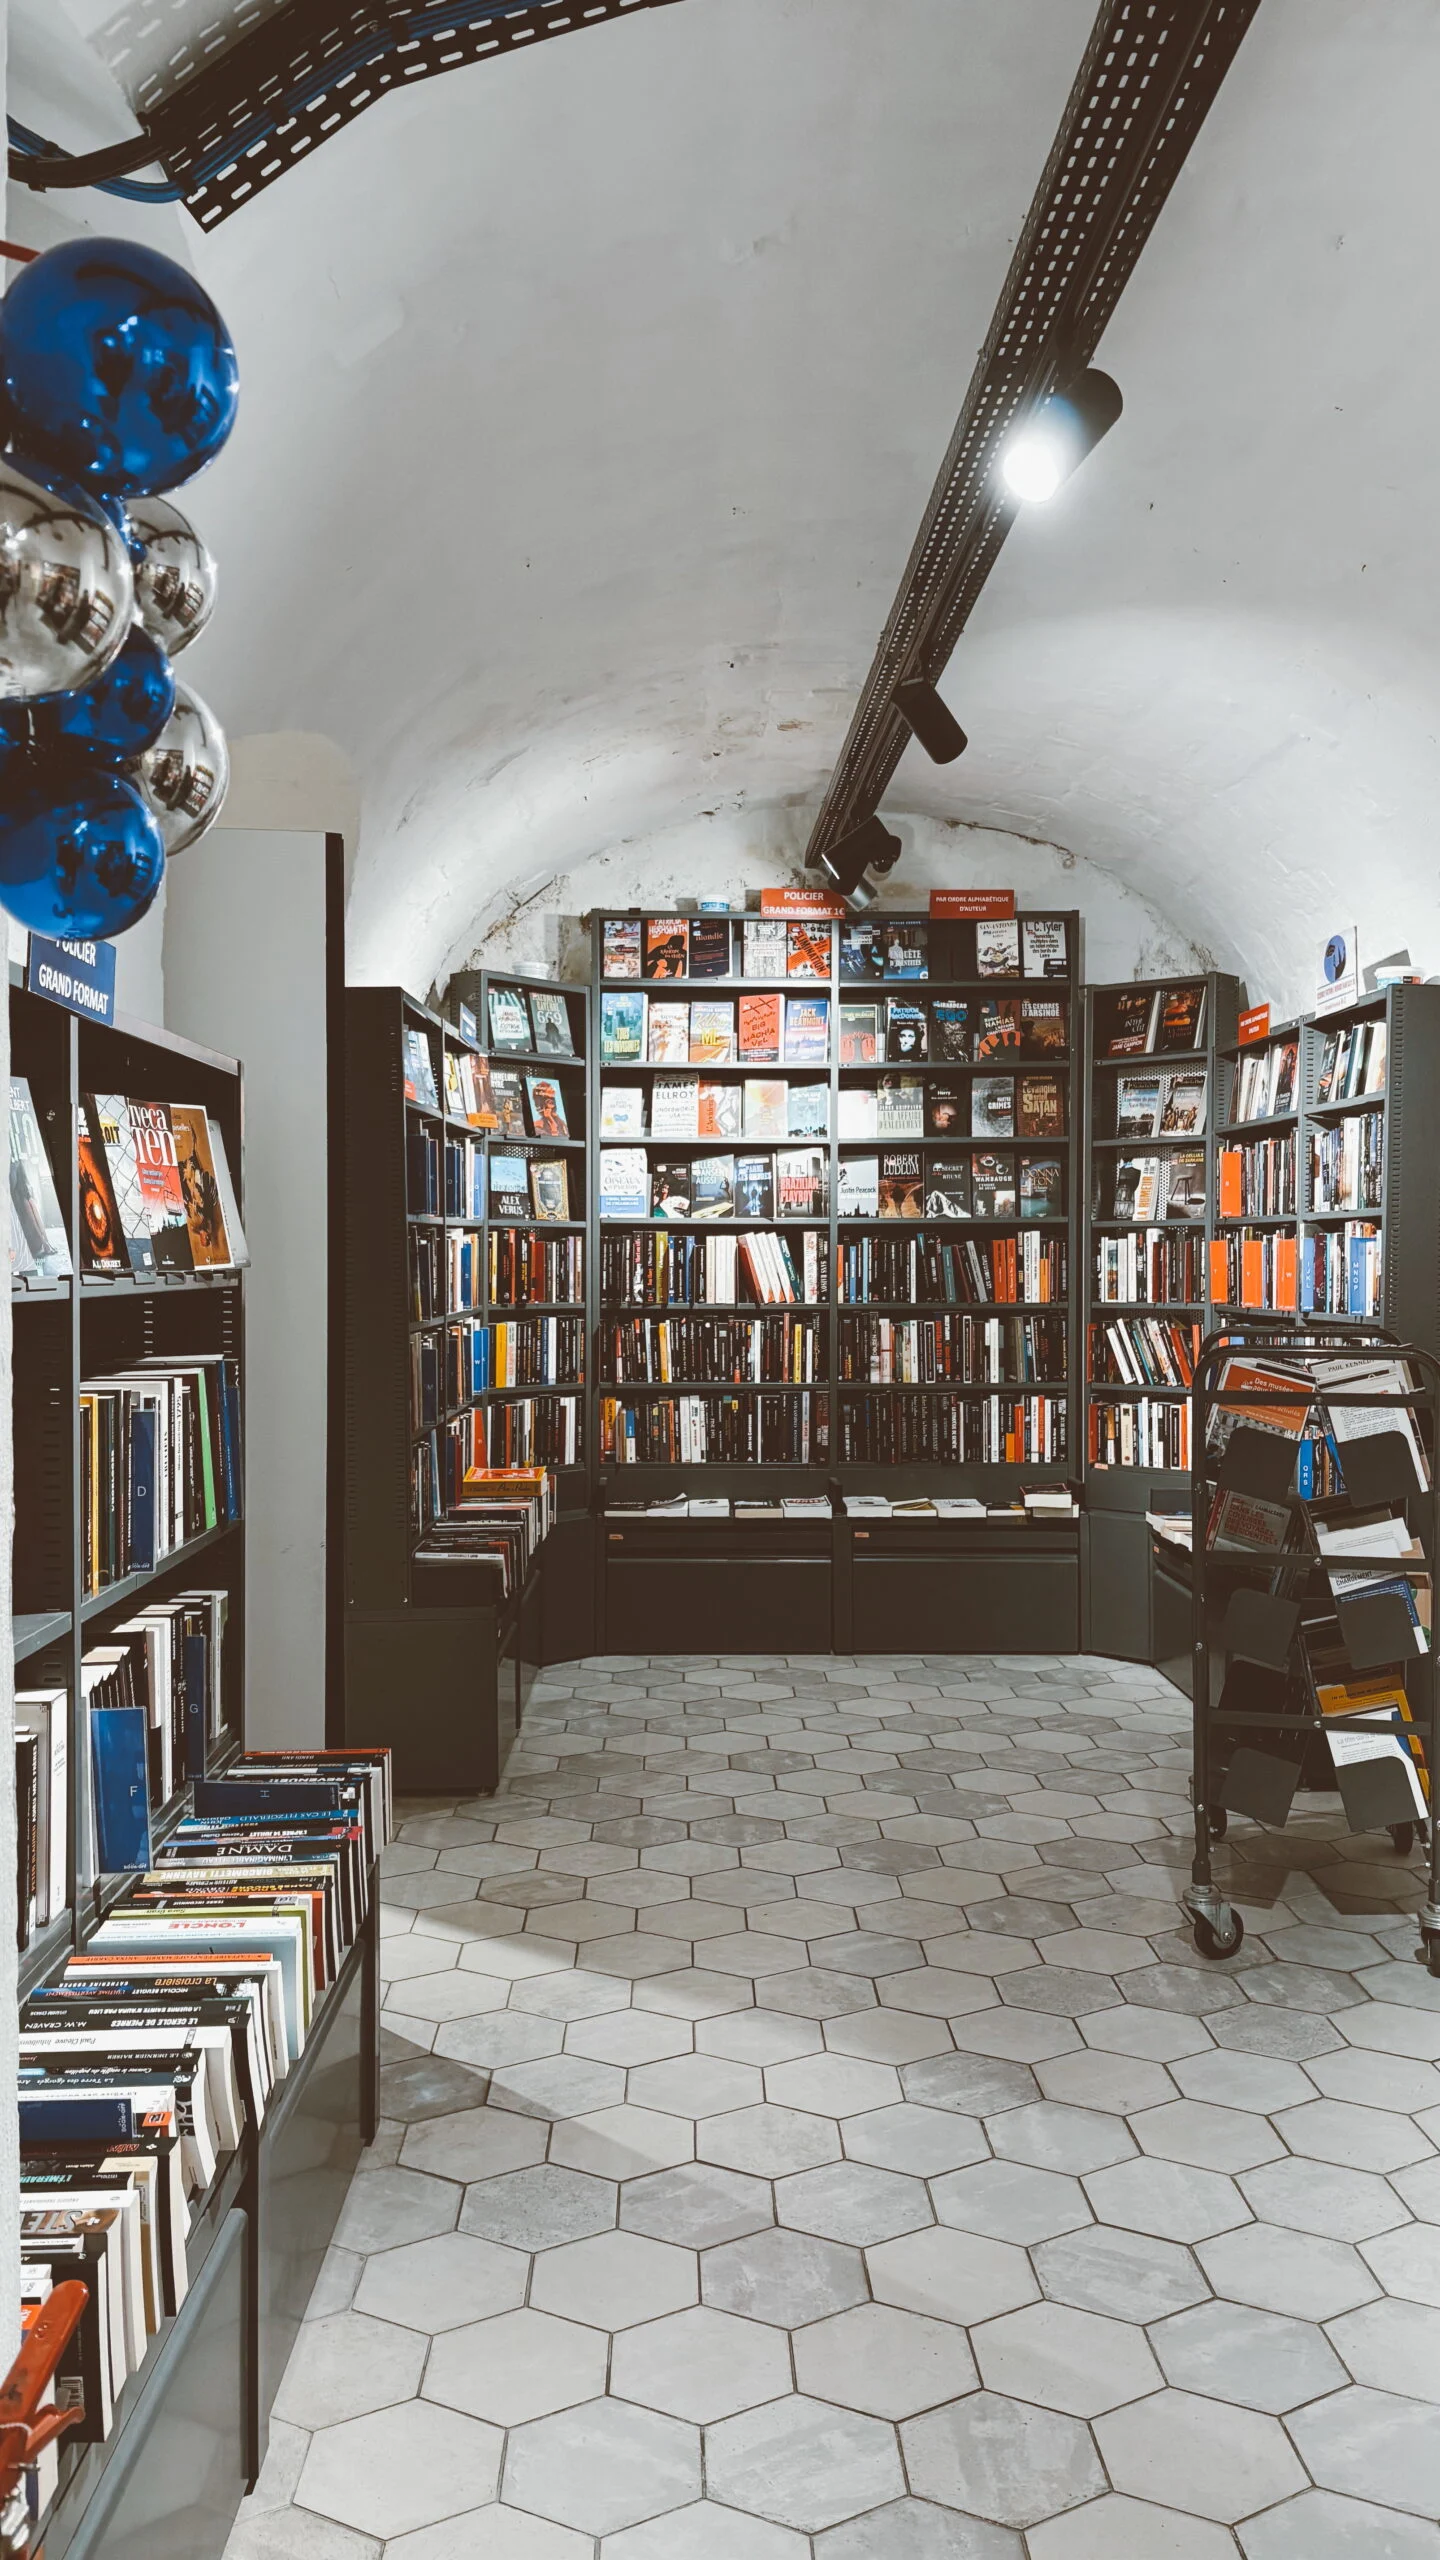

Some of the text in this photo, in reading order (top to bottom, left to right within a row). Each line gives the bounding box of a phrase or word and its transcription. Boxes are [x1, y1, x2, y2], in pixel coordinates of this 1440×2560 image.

[784, 892, 824, 900] POLICIER
[763, 906, 795, 914] GRAND
[796, 907, 832, 915] FORMAT
[1043, 921, 1062, 934] Tyler
[39, 964, 109, 1015] GRAND FORMAT
[537, 1011, 562, 1023] 669
[752, 1021, 765, 1030] BIG
[985, 1017, 1014, 1028] NAMIAS
[656, 1091, 695, 1099] ELLROY
[988, 1102, 1011, 1110] GRIMES
[884, 1154, 919, 1165] ROBERT
[884, 1163, 919, 1176] LUDLUM
[1022, 1169, 1059, 1177] DONNA
[780, 1177, 819, 1189] BRAZILIAN
[501, 1196, 520, 1205] ALEX
[780, 1190, 813, 1203] PLAYBOY
[498, 1205, 523, 1215] VERUS
[1328, 1364, 1342, 1372] PAUL
[1254, 1378, 1294, 1392] Des musées
[138, 1486, 146, 1497] D
[189, 1704, 199, 1714] G
[130, 1785, 138, 1797] F
[216, 1844, 292, 1856] DAMNÉ
[160, 1867, 273, 1880] GIACOMETTI RAVENNE
[203, 1976, 217, 1985] La
[64, 2020, 87, 2028] M.W.
[111, 2019, 145, 2028] PIERRES
[146, 2018, 156, 2026] DE
[157, 2018, 187, 2026] CERCLE
[80, 2037, 96, 2045] Paul
[64, 2067, 91, 2075] papillon
[21, 2210, 83, 2234] STE
